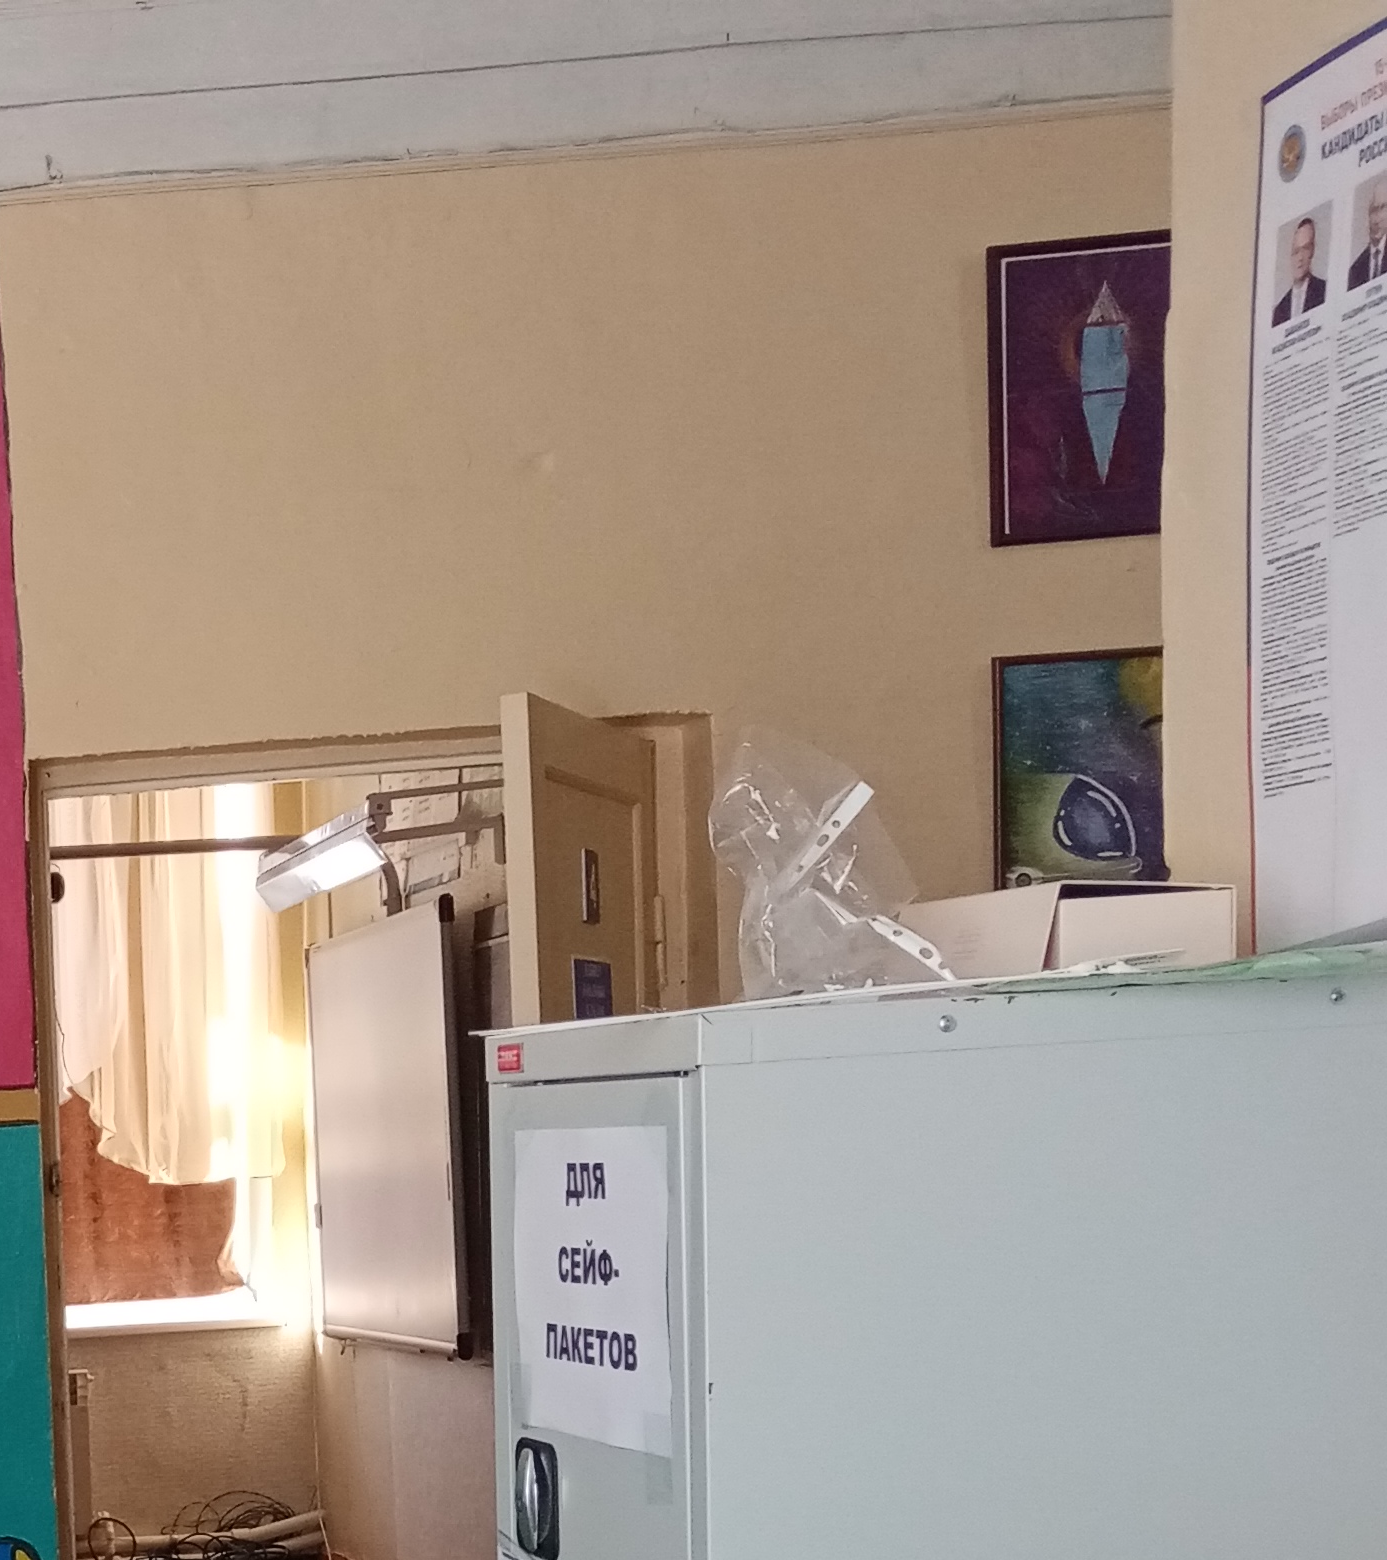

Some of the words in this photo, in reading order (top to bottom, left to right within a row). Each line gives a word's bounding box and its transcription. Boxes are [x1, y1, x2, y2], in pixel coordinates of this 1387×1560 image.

[565, 1162, 607, 1206] ДЛЯ
[558, 1239, 620, 1286] СЕЙФ-
[545, 1322, 639, 1372] ПАКЕТОВ
